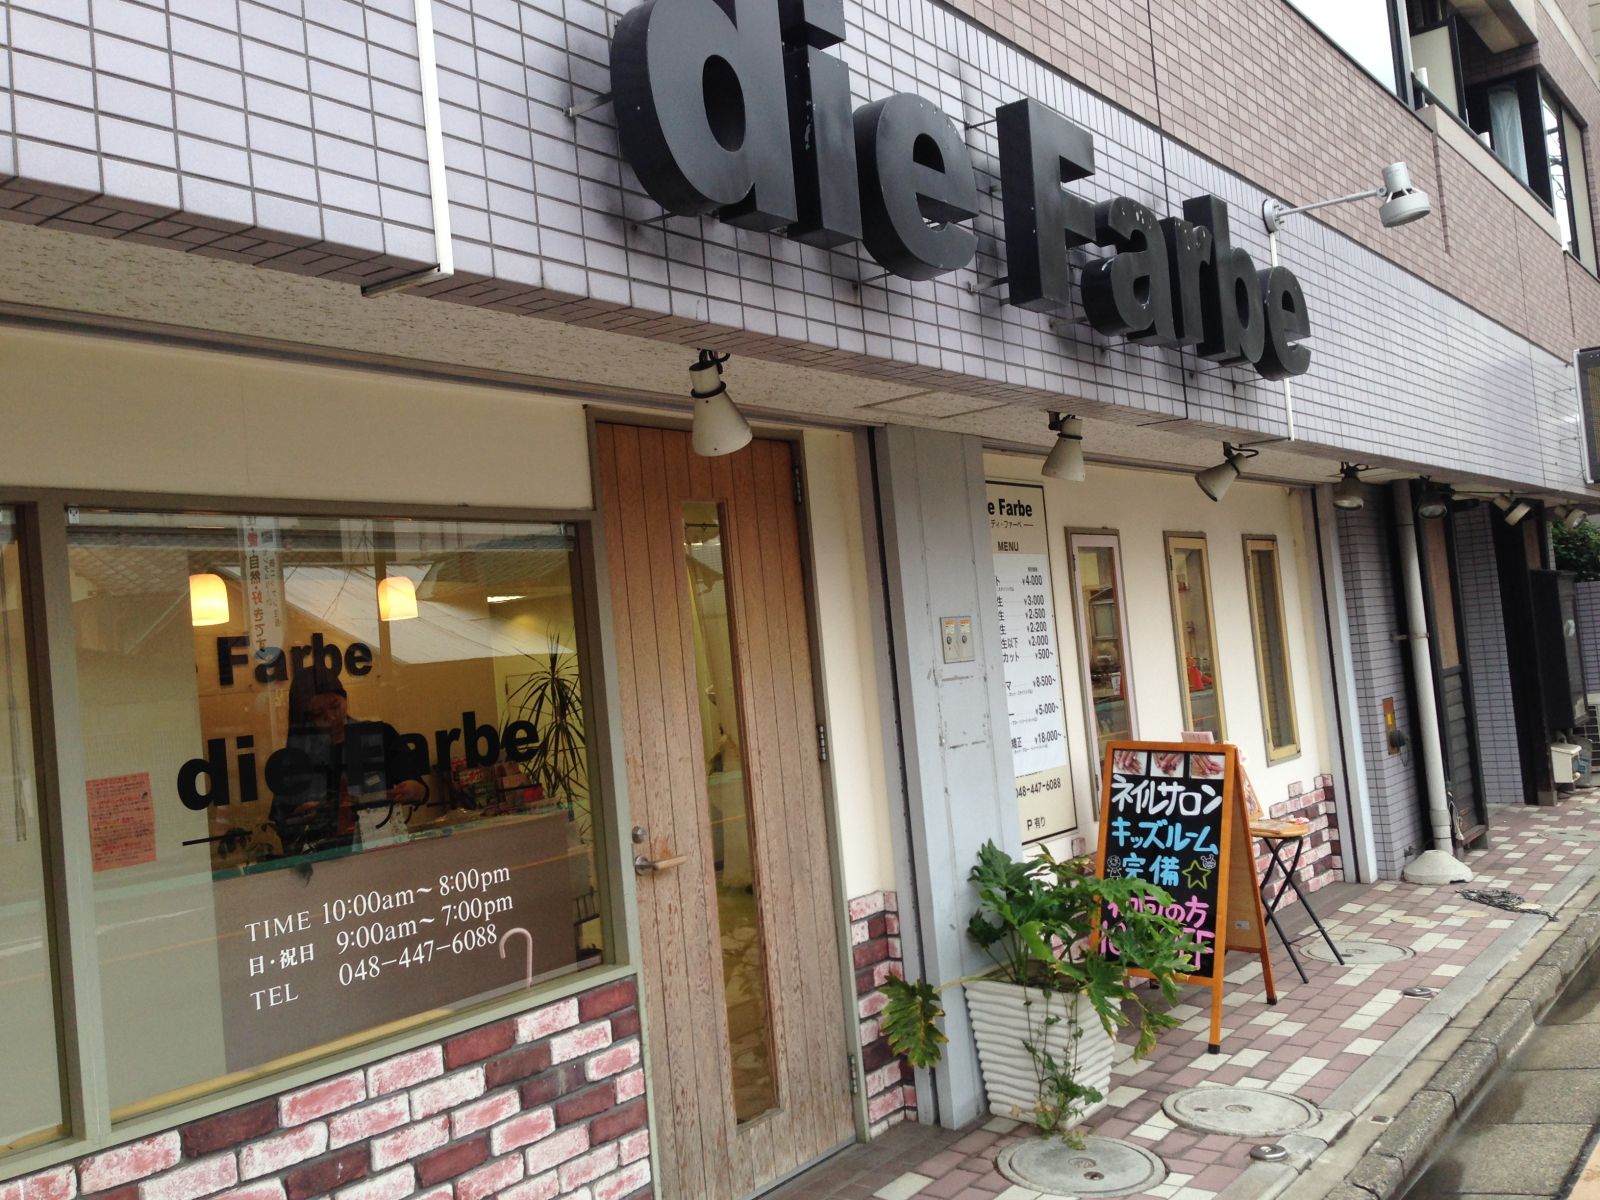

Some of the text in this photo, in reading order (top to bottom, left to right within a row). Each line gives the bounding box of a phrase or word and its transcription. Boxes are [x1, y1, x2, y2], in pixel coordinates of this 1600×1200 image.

[611, 0, 1311, 381] die Farbe
[998, 498, 1033, 517] Farbe
[997, 541, 1019, 552] MENU
[217, 633, 373, 687] Farbe
[1001, 637, 1018, 650] 生以下
[1002, 651, 1020, 663] カット
[350, 711, 540, 785] arbe
[1111, 773, 1223, 816] ネイルサロン
[1027, 819, 1033, 831] P
[1111, 816, 1219, 855] キッズルーム
[1122, 852, 1180, 888] 完備
[244, 910, 312, 942] TIME
[439, 866, 512, 896] 8:00pm
[249, 942, 315, 977] 日・祝日
[441, 895, 514, 926] 7:00pm
[250, 922, 498, 1011] TEL 048-447-6088
